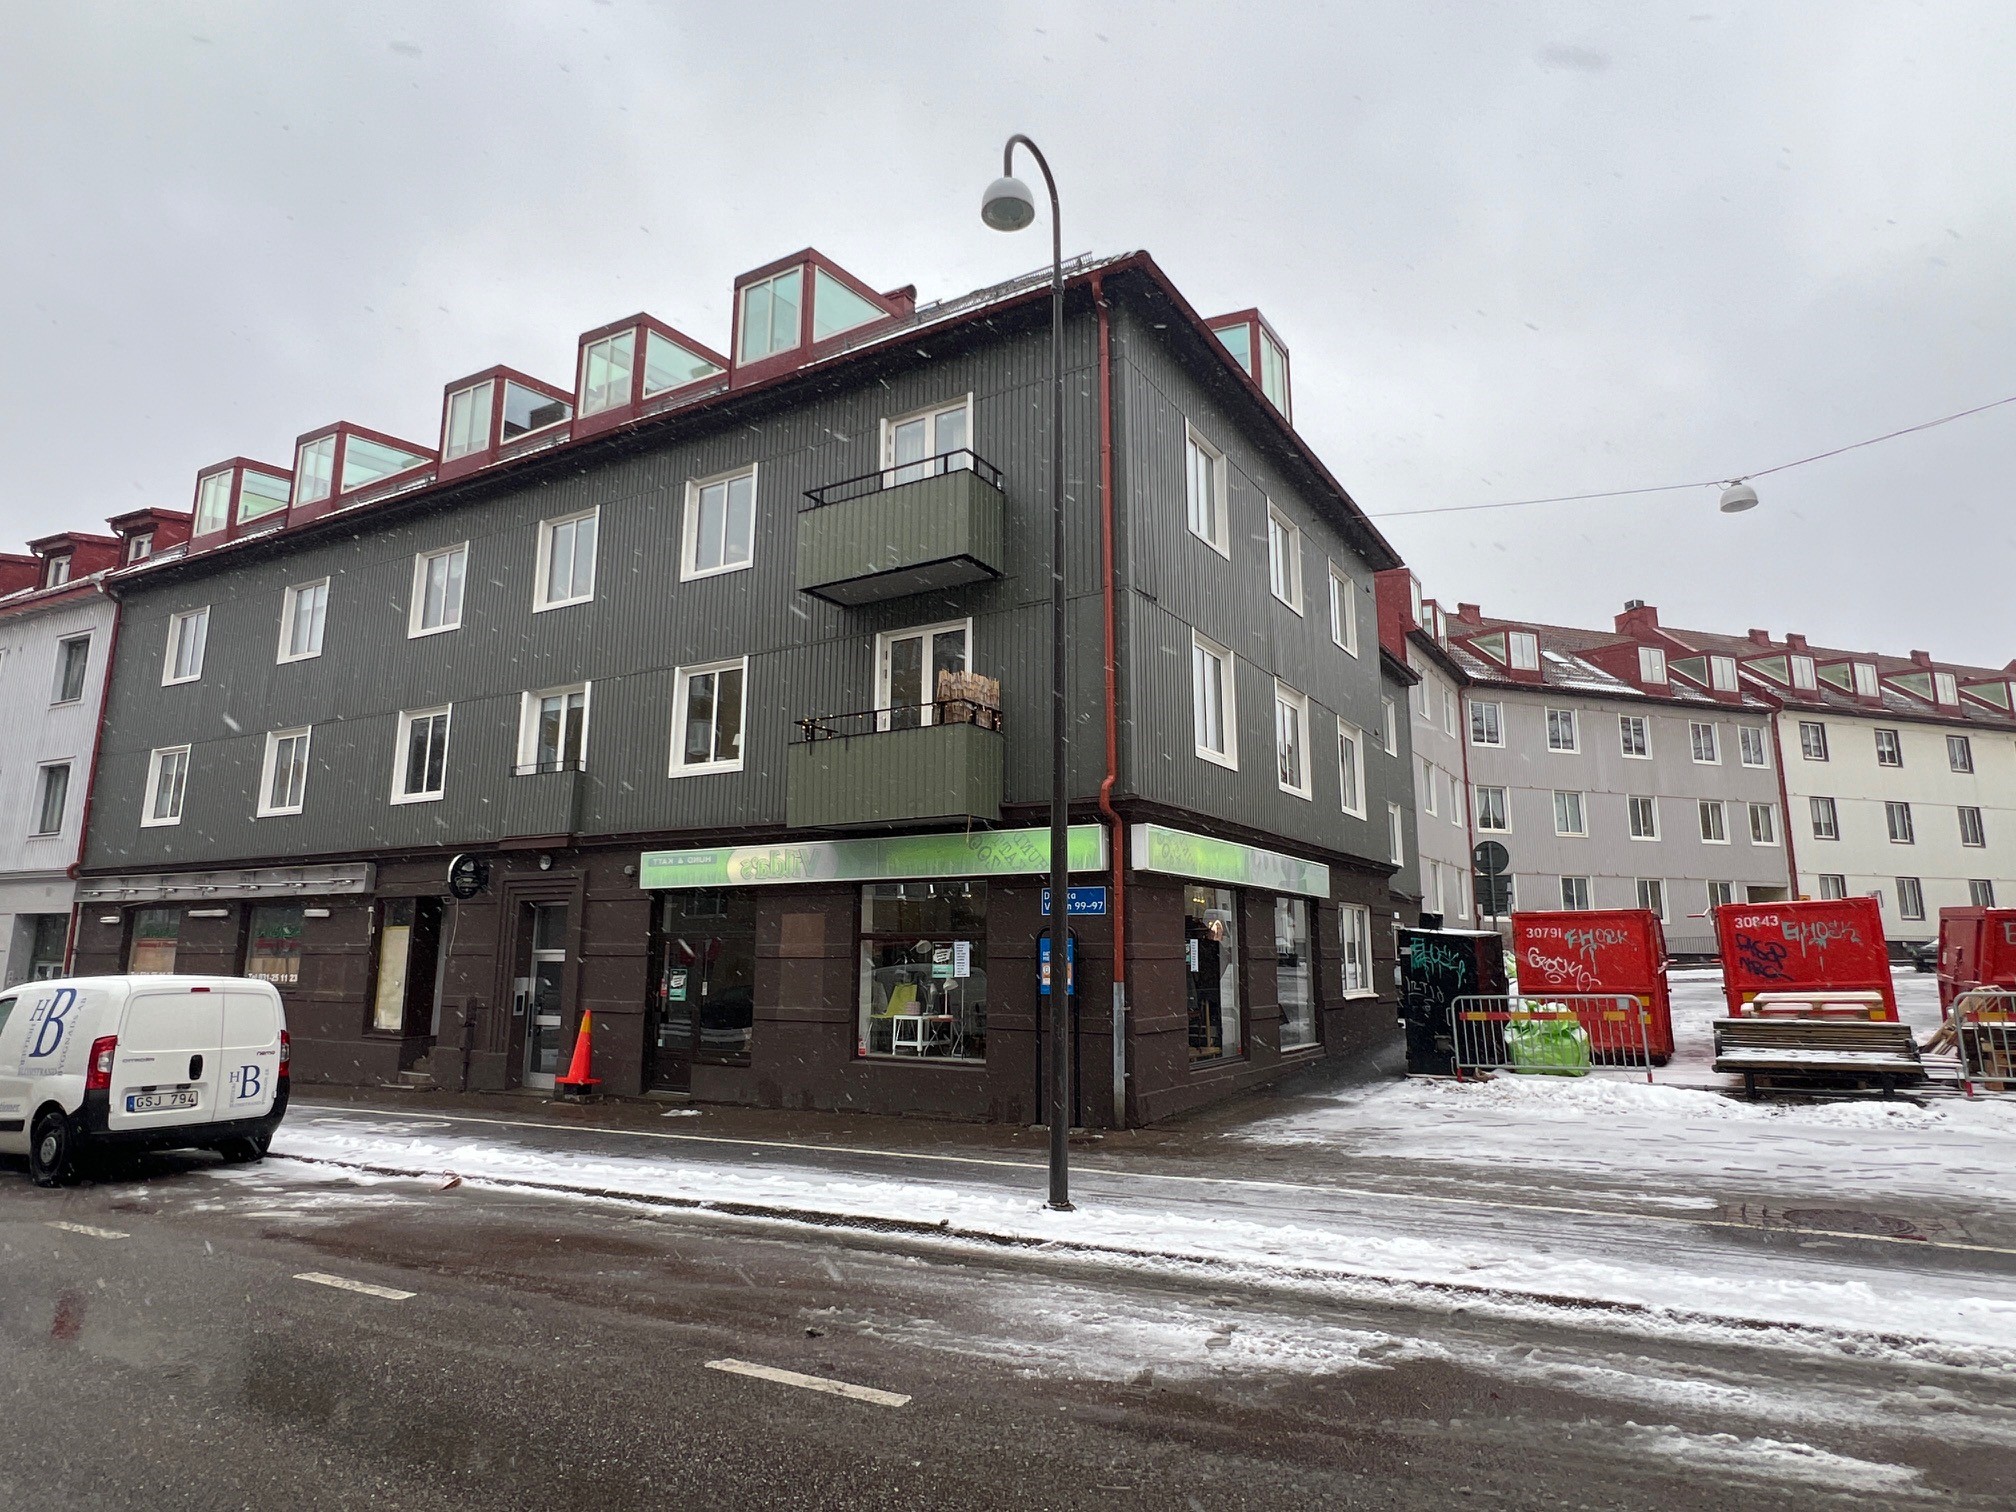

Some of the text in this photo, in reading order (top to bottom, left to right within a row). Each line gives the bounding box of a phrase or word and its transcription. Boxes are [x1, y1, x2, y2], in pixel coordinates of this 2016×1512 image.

[1526, 928, 1562, 939] 30791
[136, 1093, 195, 1108] GSJ 794
